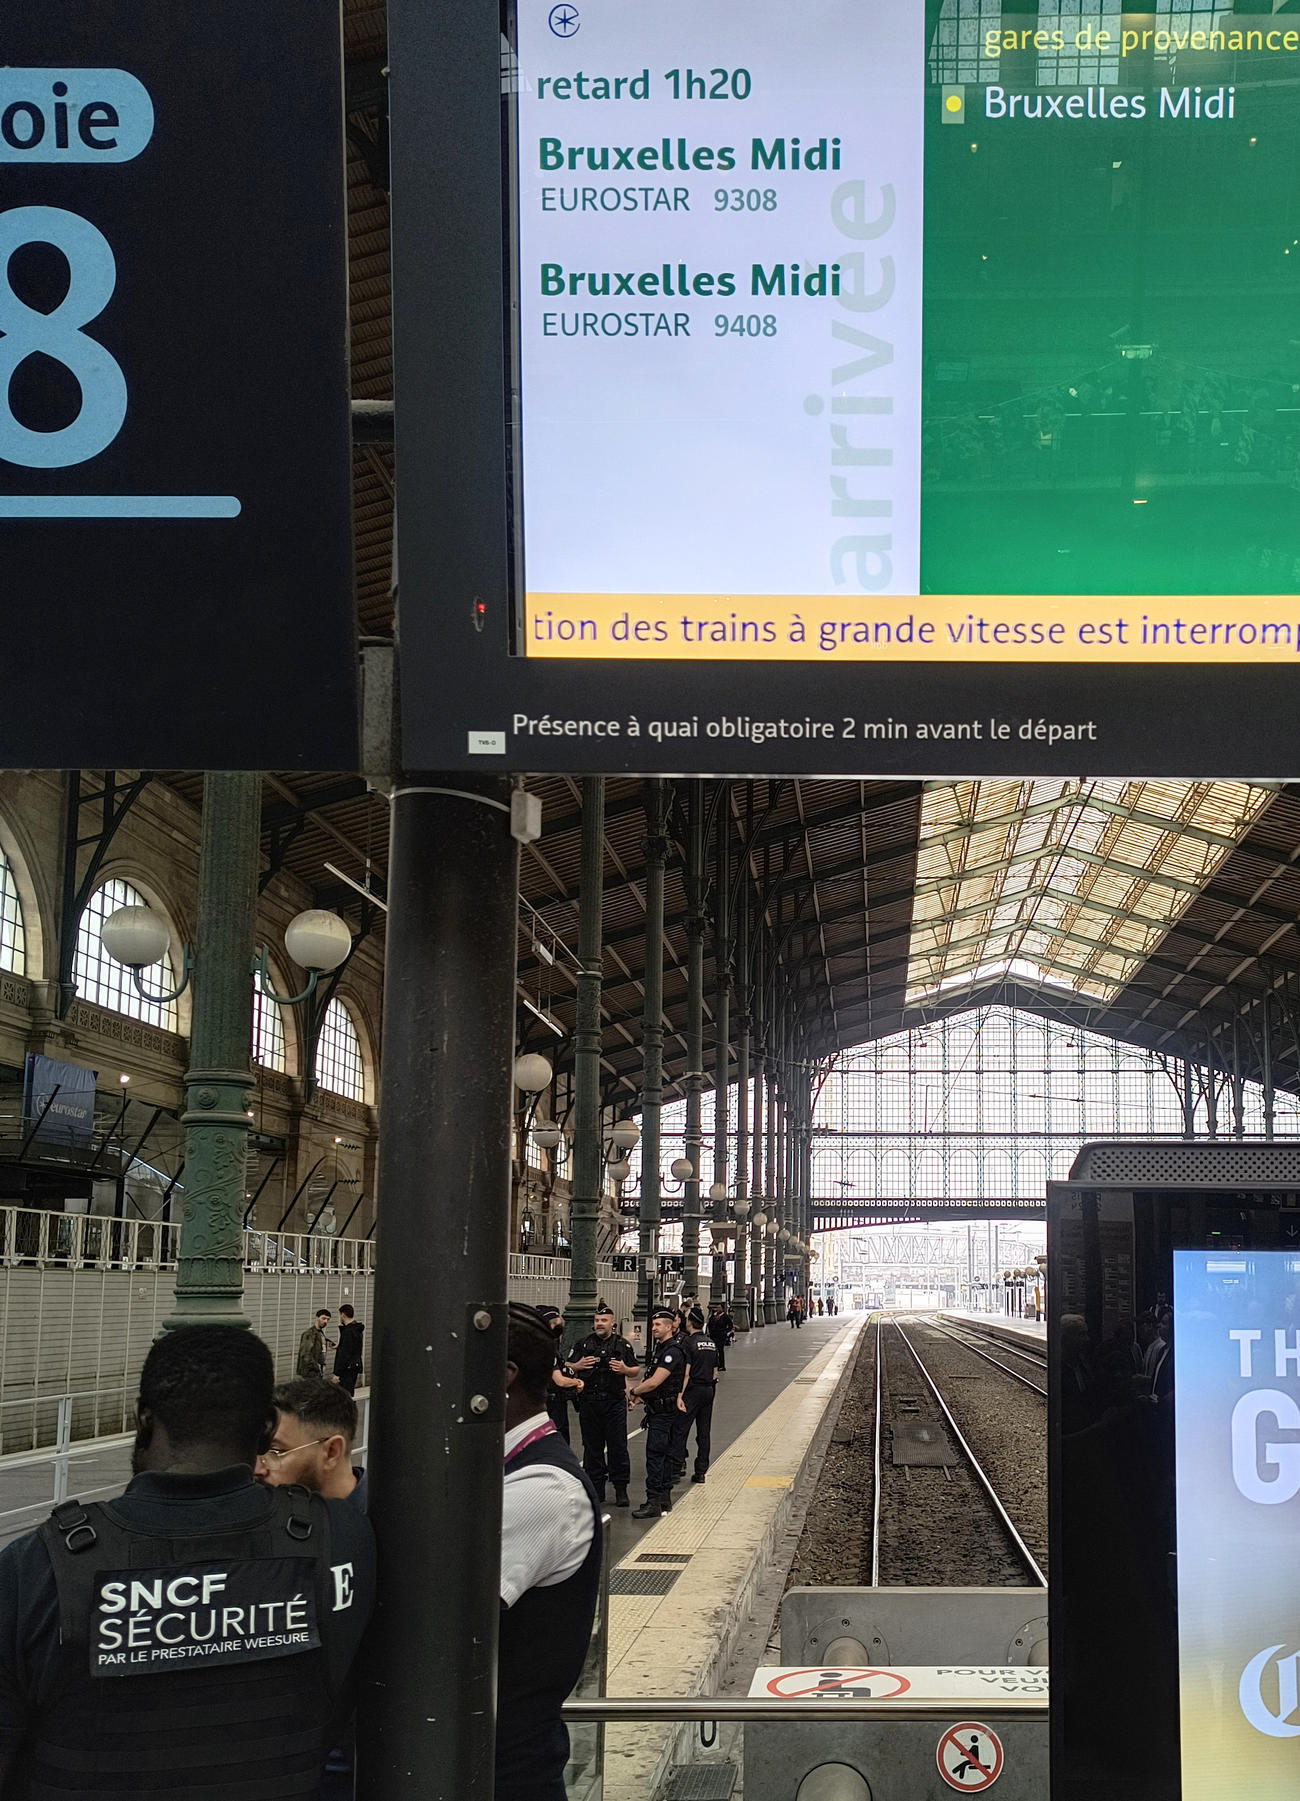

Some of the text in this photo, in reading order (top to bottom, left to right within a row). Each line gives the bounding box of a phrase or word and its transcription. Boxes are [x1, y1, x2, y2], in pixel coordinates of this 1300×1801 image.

[984, 23, 1299, 57] gares de provenance
[537, 68, 751, 100] retard 1h20
[1, 81, 120, 150] oie
[985, 86, 1235, 119] Bruxelles Midi
[539, 137, 841, 171] Bruxelles Midi
[541, 187, 778, 212] EUROSTAR 9308
[540, 263, 841, 297] Bruxelles Midi
[0, 206, 127, 469] 8
[543, 312, 777, 337] EUROSTAR 9408
[803, 179, 897, 592] arrivée
[534, 611, 597, 641] tion
[611, 612, 668, 642] des
[680, 612, 777, 643] trains
[788, 614, 806, 643] à
[819, 615, 936, 651] grande
[946, 614, 1066, 644] vitesse
[1078, 618, 1129, 645] est
[513, 713, 1097, 746] Présence à quai obligatoire 2 min avant le départ
[623, 1259, 633, 1271] R
[664, 1259, 674, 1271] R
[98, 1573, 228, 1614] SNCF
[98, 1593, 308, 1650] SÉCURITÉ
[98, 1631, 310, 1665] PAR LE PRESTATAIRE WEESURE
